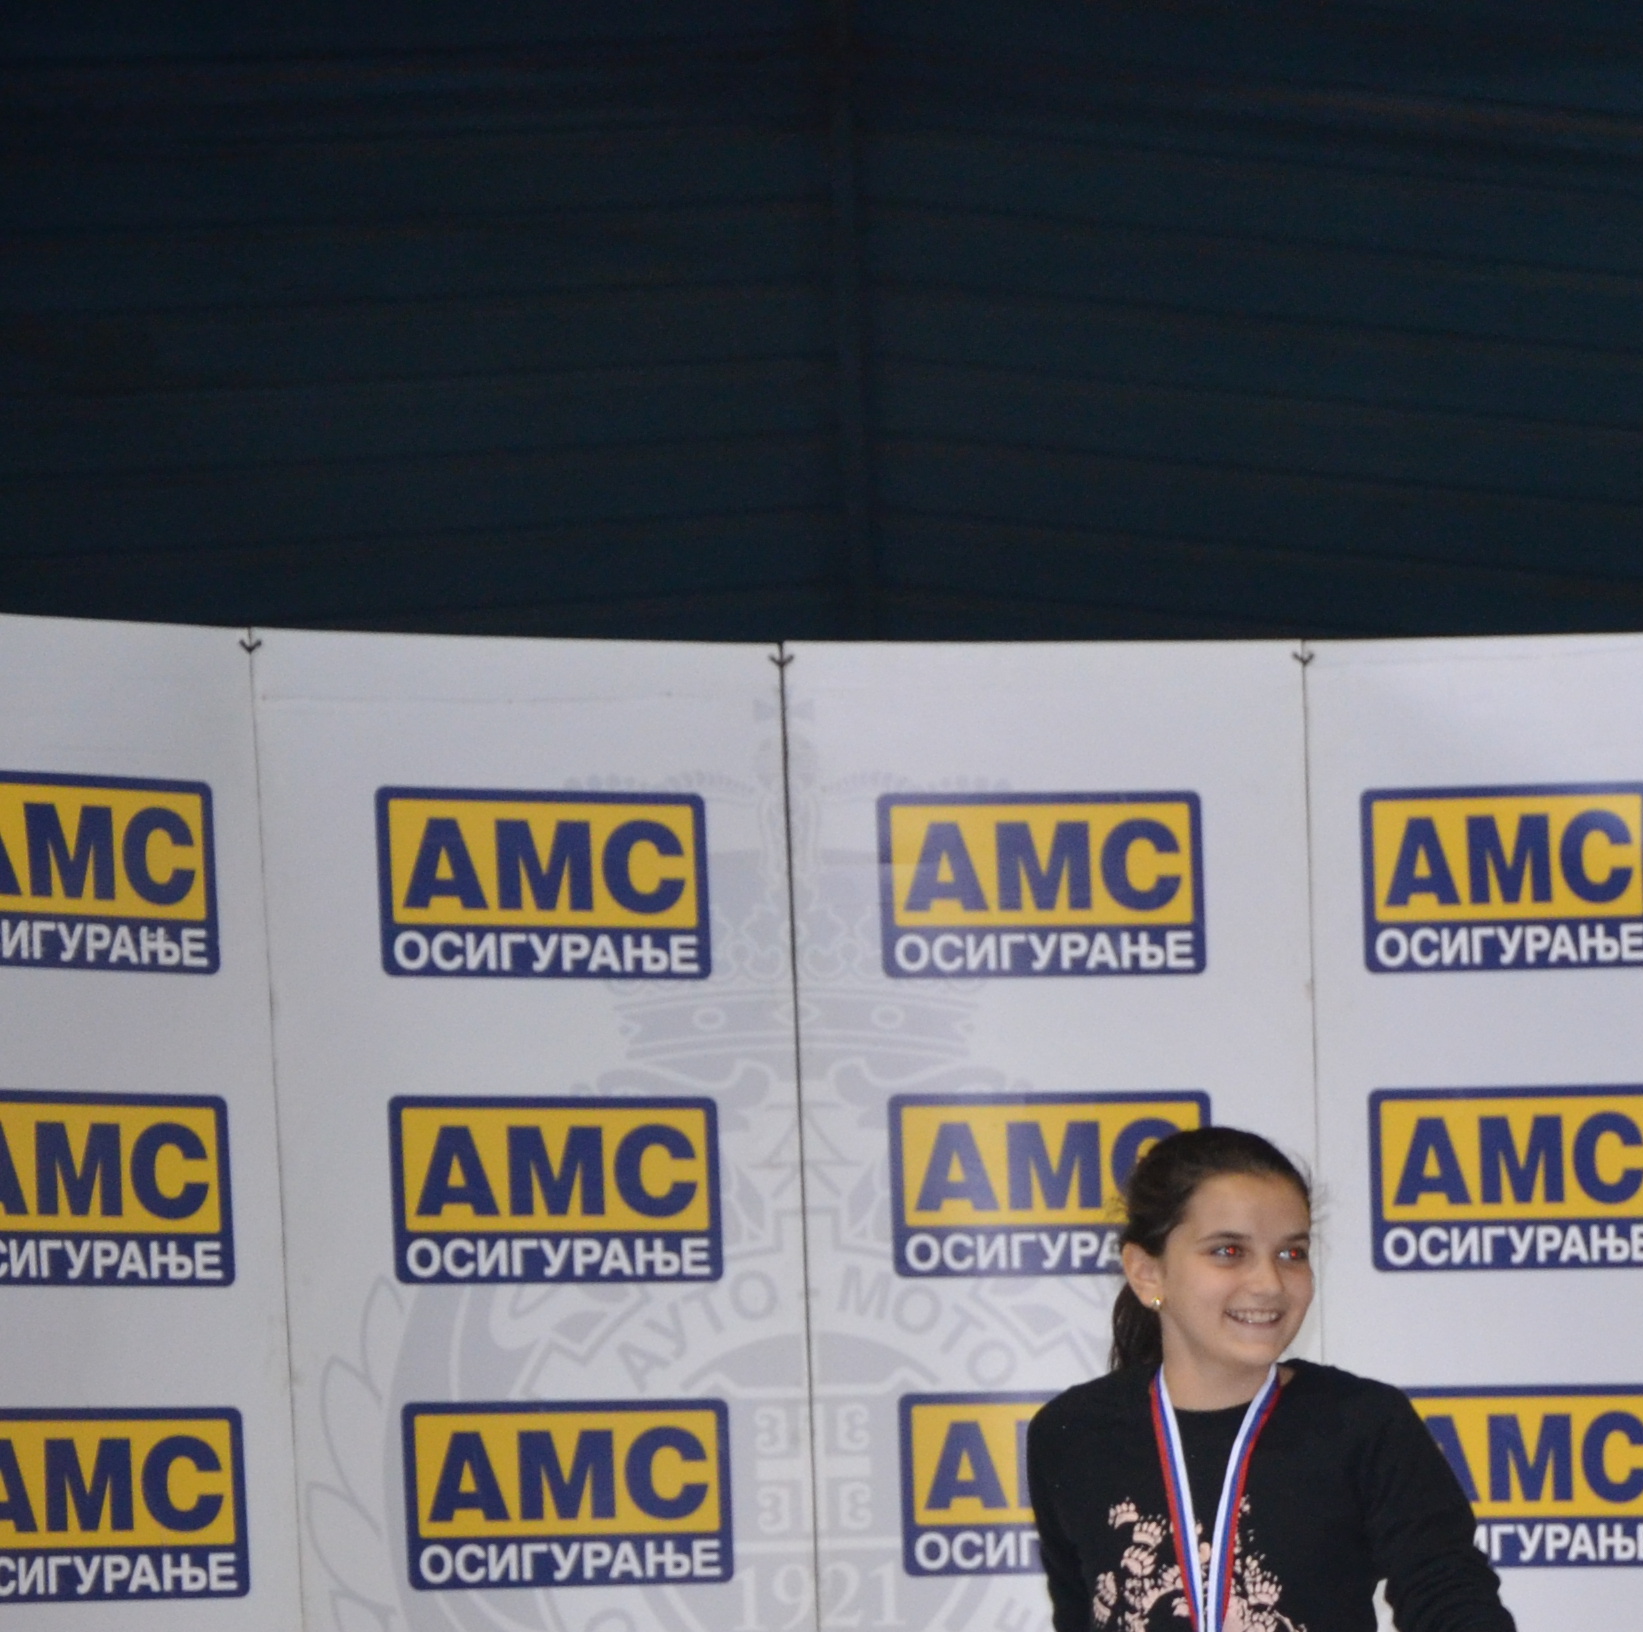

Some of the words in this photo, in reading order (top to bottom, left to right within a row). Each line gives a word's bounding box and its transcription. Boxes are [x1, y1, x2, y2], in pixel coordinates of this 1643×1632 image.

[0, 802, 196, 905] МС
[403, 815, 688, 916] АМС
[903, 818, 1183, 912] АМС
[1386, 809, 1633, 907] АМС
[0, 920, 208, 967] ИГУРАЊЕ
[393, 930, 699, 973] ОСИГУРАЊЕ
[895, 928, 1195, 971] ОСИГУРАЊЕ
[416, 1123, 698, 1217] АМС
[1394, 1109, 1643, 1204] АМС
[0, 1238, 223, 1280] ИГУРАЊЕ
[405, 1237, 710, 1278] ОСИГУРАЊЕ
[905, 1231, 1123, 1271] ОСИГУРА
[618, 1269, 775, 1393] АУТО
[836, 1266, 1019, 1386] МОТО
[429, 1427, 710, 1520] АМС
[0, 1552, 237, 1596] СИГУРАЊЕ
[419, 1539, 723, 1584] ОСИГУРАЊЕ
[731, 1557, 905, 1632] 1921
